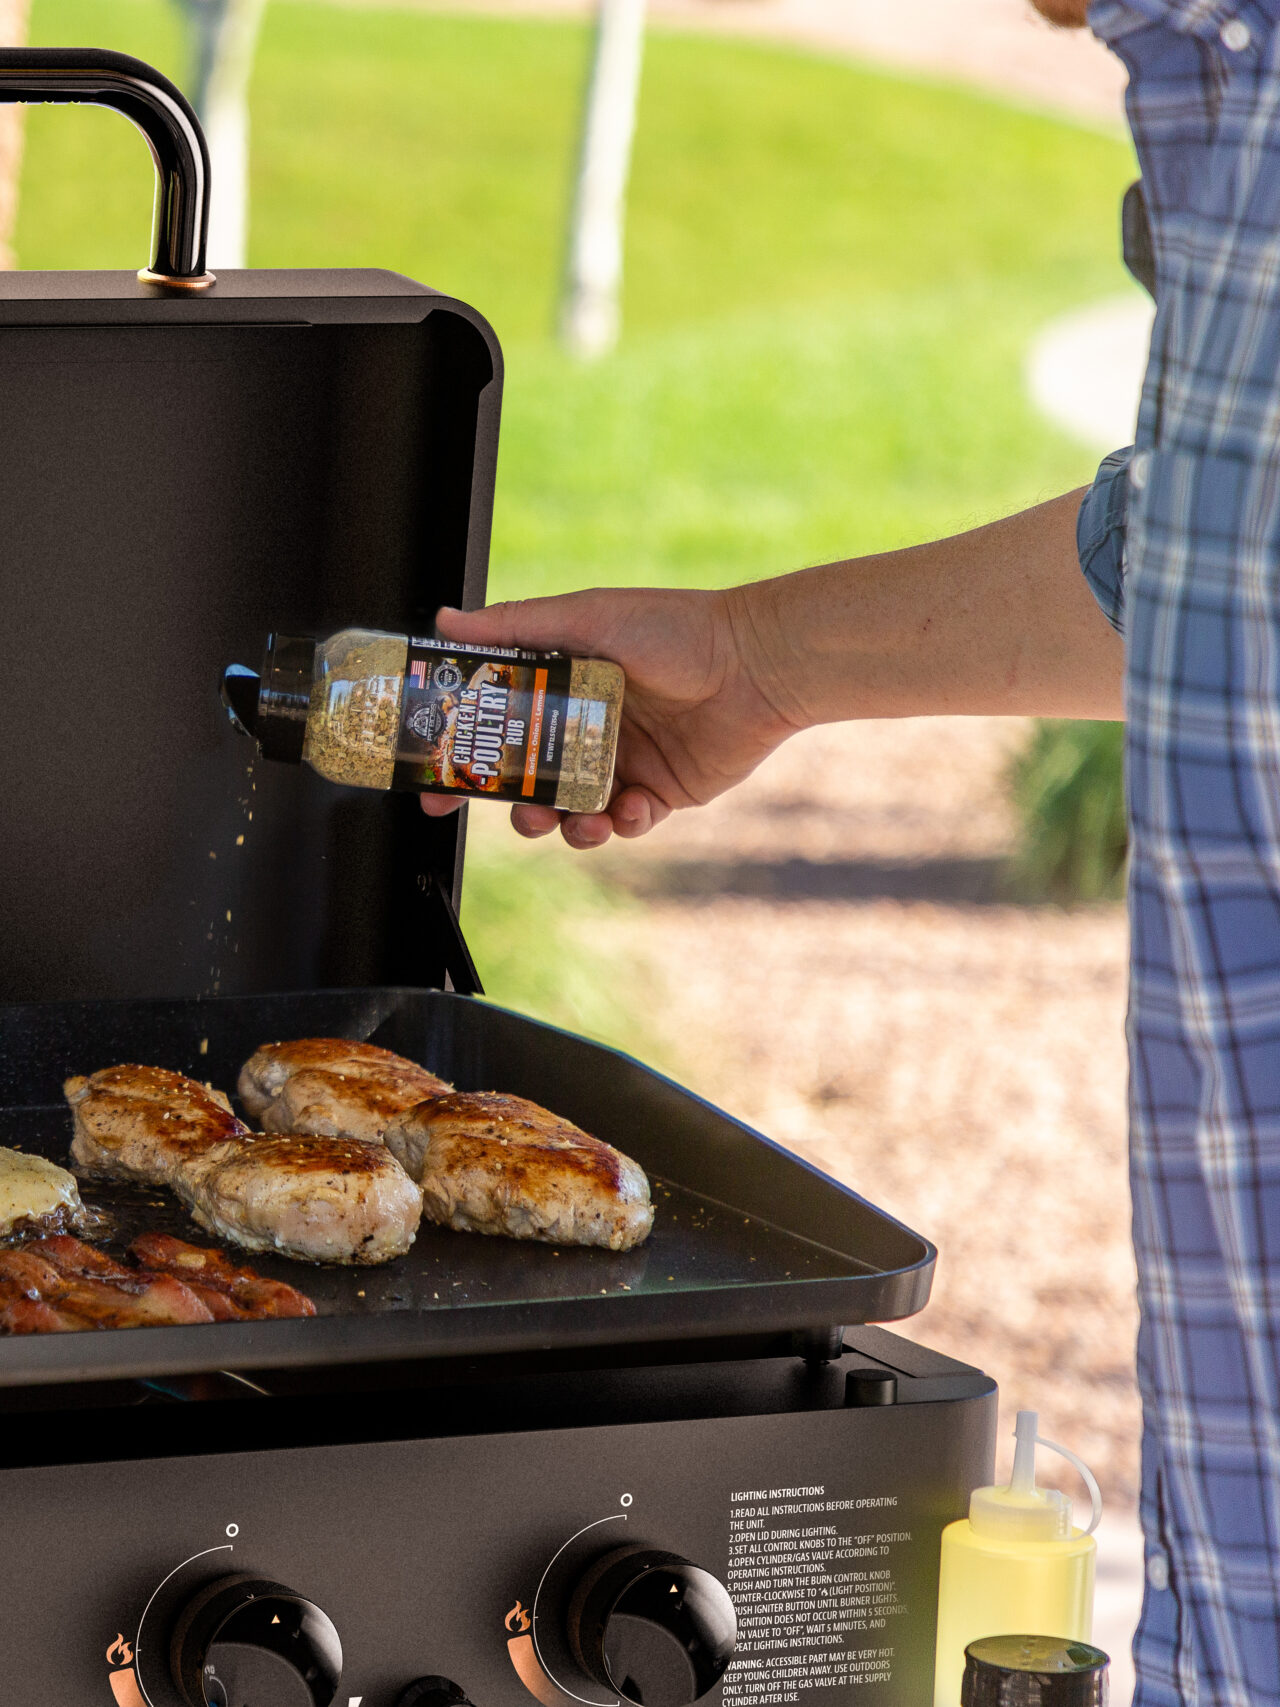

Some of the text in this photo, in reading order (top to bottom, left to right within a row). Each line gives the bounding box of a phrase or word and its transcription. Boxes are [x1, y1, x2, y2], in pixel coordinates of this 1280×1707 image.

[429, 704, 437, 727] BOSS
[453, 689, 478, 764] CHICKEN &
[506, 720, 525, 745] RUB
[528, 690, 544, 775] Garlic Onion Lemon
[731, 1486, 824, 1501] LIGHTING INSTRUCTIONS
[730, 1497, 897, 1518] 1.READ ALL INSTRUCTIONS BEFORE OPERATING
[729, 1526, 838, 1543] 2.OPEN LID DURING LIGHTING.
[730, 1519, 765, 1530] THE UNIT.
[729, 1546, 747, 1555] 3.SET
[749, 1545, 762, 1554] ALL
[764, 1541, 797, 1552] CONTROL
[800, 1539, 825, 1549] KNOBS
[827, 1538, 836, 1547] TO
[839, 1537, 852, 1546] THE
[877, 1532, 912, 1543] POSITION.
[728, 1546, 889, 1567] 4.OPEN CYLINDER/GAS VALVE ACCORDING TO
[728, 1564, 826, 1579] OPERATING INSTRUCTIONS.
[728, 1570, 890, 1592] 5.PUSH AND TURN THE BURN CONTROL KNOB
[730, 1589, 805, 1604] OUNTER-CLOCKWISE
[807, 1588, 817, 1597] TO
[735, 1605, 752, 1616] PUSH
[755, 1603, 783, 1614] IGNITER
[786, 1600, 815, 1612] BUTTON
[818, 1598, 838, 1609] UNTIL
[841, 1595, 870, 1607] BURNER
[739, 1616, 772, 1627] IGNITION
[774, 1614, 793, 1624] DOES
[795, 1612, 811, 1622] NOT
[813, 1611, 837, 1621] OCCUR
[839, 1608, 867, 1619] WITHIN
[868, 1607, 873, 1616] 5
[736, 1631, 745, 1640] RN
[747, 1628, 769, 1638] VALVE
[772, 1627, 781, 1637] TO
[807, 1623, 825, 1634] WAIT
[827, 1623, 831, 1632] 5
[833, 1621, 867, 1632] MINUTES,
[870, 1619, 885, 1628] AND
[734, 1634, 844, 1652] PEAT LIGHTING INSTRUCTIONS.
[766, 1656, 807, 1667] ACCESSIBLE
[809, 1654, 827, 1664] PART
[829, 1652, 845, 1662] MAY
[848, 1651, 856, 1660] BE
[858, 1649, 877, 1659] VERY
[879, 1648, 895, 1657] HOT.
[723, 1660, 890, 1683] KEEP YOUNG CHILDREN AWAY. USE OUTDOORS
[723, 1672, 892, 1696] ONLY. TURN OFF THE GAS VALVE AT THE SUPPLY
[722, 1692, 799, 1707] CYLINDER AFTER USE.
